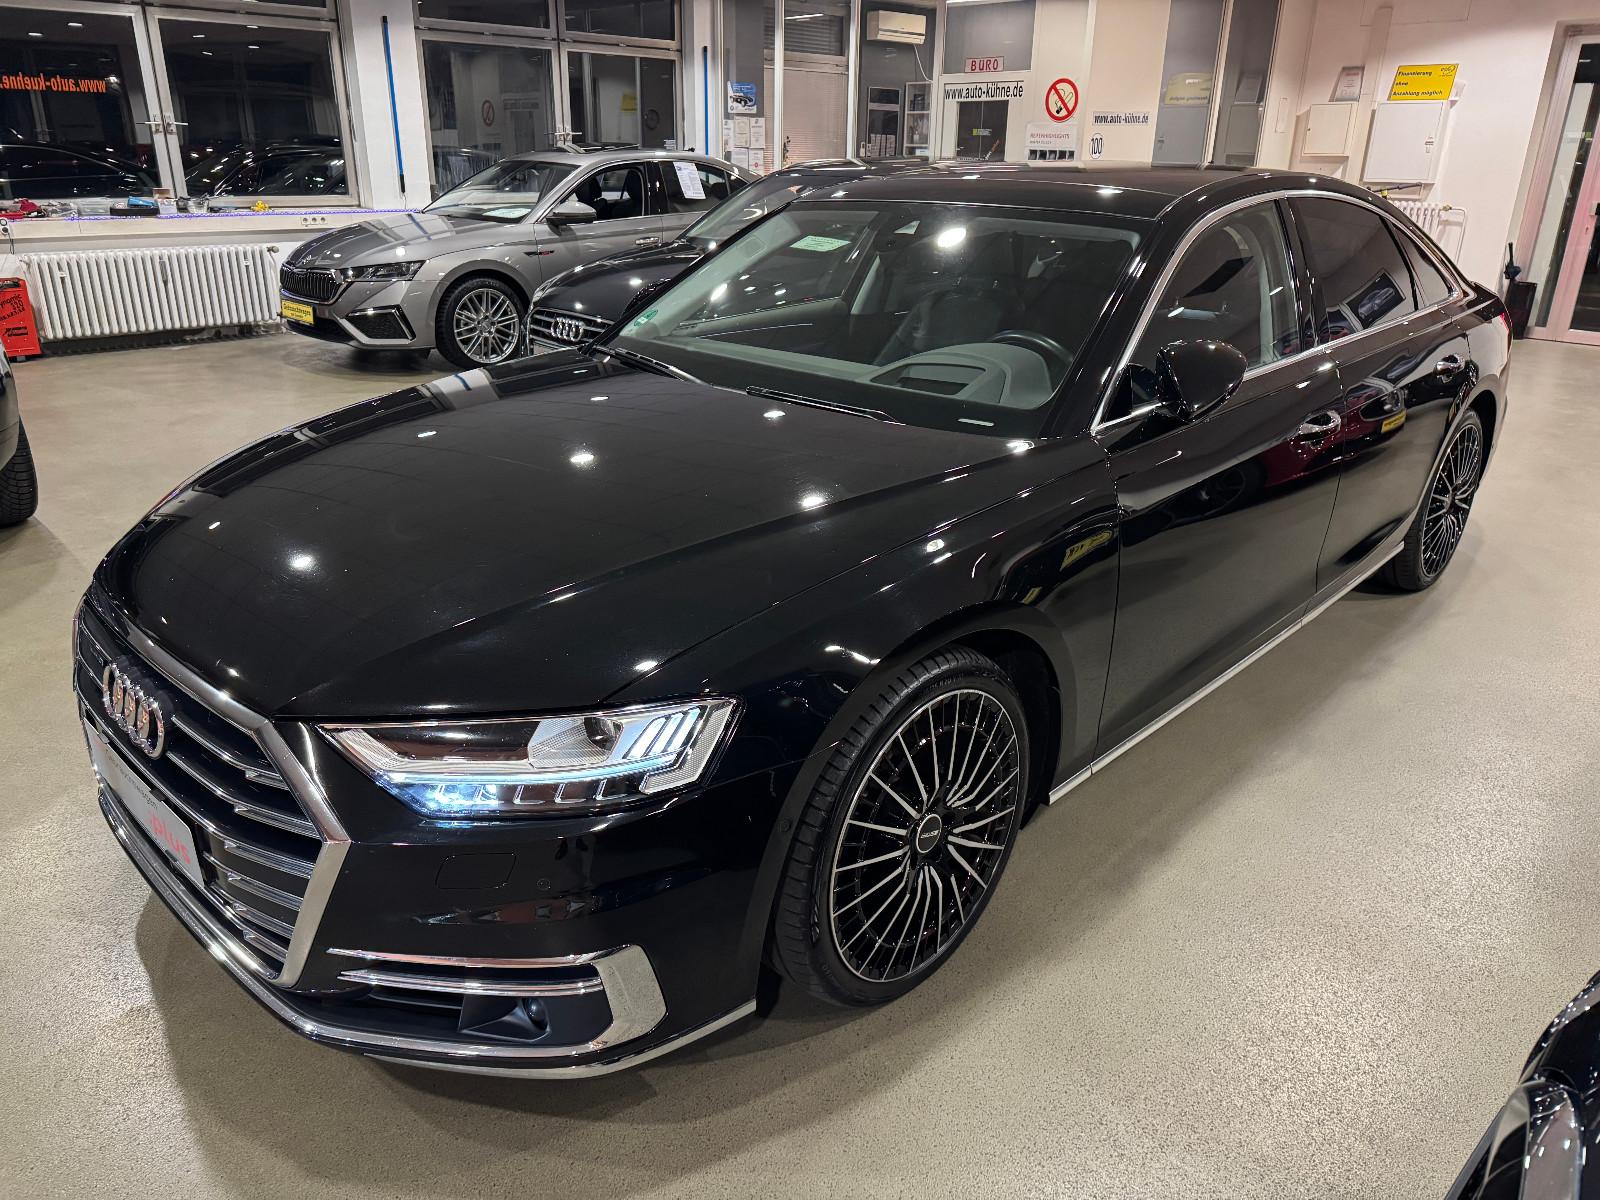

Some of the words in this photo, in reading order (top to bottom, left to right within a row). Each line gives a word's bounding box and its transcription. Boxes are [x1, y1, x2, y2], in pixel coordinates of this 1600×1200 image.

[944, 82, 1024, 100] www.auto-kühne.de
[1094, 113, 1149, 124] www.auto-kühne.de
[1091, 137, 1103, 155] 100
